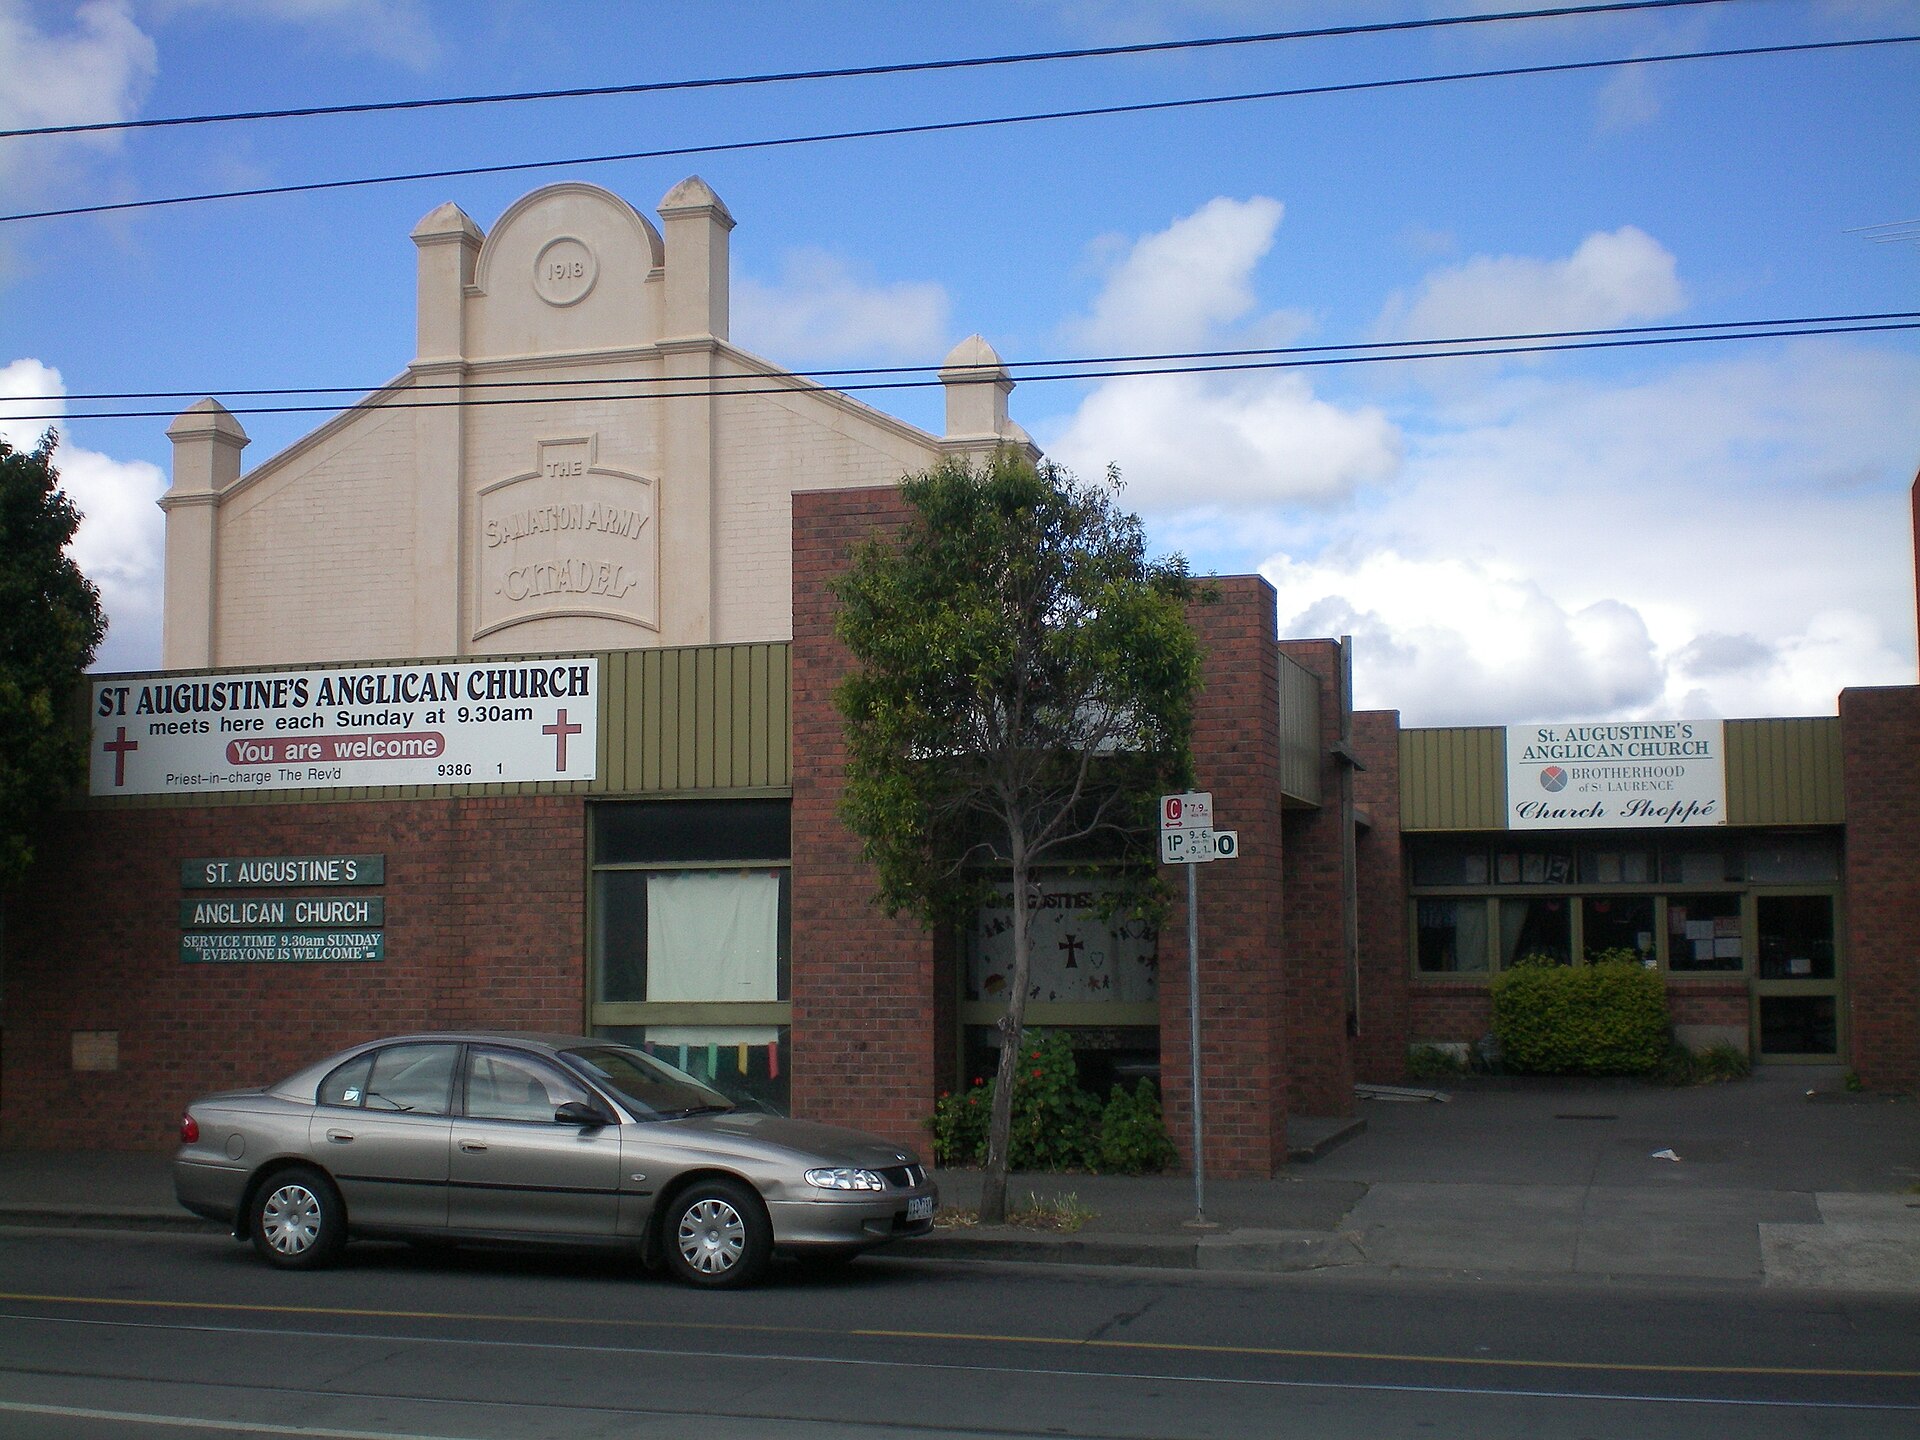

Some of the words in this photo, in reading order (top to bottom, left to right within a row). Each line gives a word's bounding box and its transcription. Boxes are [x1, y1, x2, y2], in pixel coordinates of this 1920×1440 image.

[548, 260, 584, 280] 1918
[546, 460, 582, 477] THE
[485, 502, 584, 548] SALVATION
[585, 502, 650, 540] ARMY
[503, 558, 630, 601] CITADEL
[98, 686, 130, 717] ST
[136, 677, 310, 715] AUGUSTINE'S
[316, 671, 460, 706] ANGLICAN
[467, 665, 590, 701] CHURCH
[149, 719, 210, 736] meets
[220, 716, 265, 733] here
[275, 712, 324, 730] each
[336, 709, 414, 729] Sunday
[425, 708, 446, 724] at
[457, 705, 534, 723] 9.30am
[1537, 728, 1560, 743] St.
[1565, 722, 1693, 742] AUGUSTINE'S
[233, 741, 274, 762] You
[284, 743, 322, 760] are
[334, 737, 438, 758] welcome
[1522, 743, 1624, 759] ANGLICAN
[1627, 741, 1709, 757] CHURCH
[166, 769, 272, 785] Priest-in-charge
[279, 768, 302, 781] The
[308, 767, 342, 781] Rev'd
[1571, 765, 1685, 780] BROTHERHOOD
[1579, 781, 1589, 793] of
[1608, 780, 1675, 792] LAURENCE
[1170, 800, 1178, 818] C
[1515, 800, 1608, 820] Church
[1619, 798, 1718, 824] Shoppé
[1167, 835, 1183, 851] 1P
[206, 863, 233, 883] ST.
[237, 859, 358, 883] AUGUSTINE'S
[194, 902, 284, 924] ANGLICAN
[295, 901, 369, 923] CHURCH
[183, 935, 240, 948] SERVICE
[242, 935, 277, 947] TIME
[281, 934, 325, 947] 9.30am
[327, 934, 380, 946] SUNDAY
[195, 947, 275, 961] "EVERYONE
[277, 948, 290, 960] IS
[292, 946, 369, 960] WELCOME"
